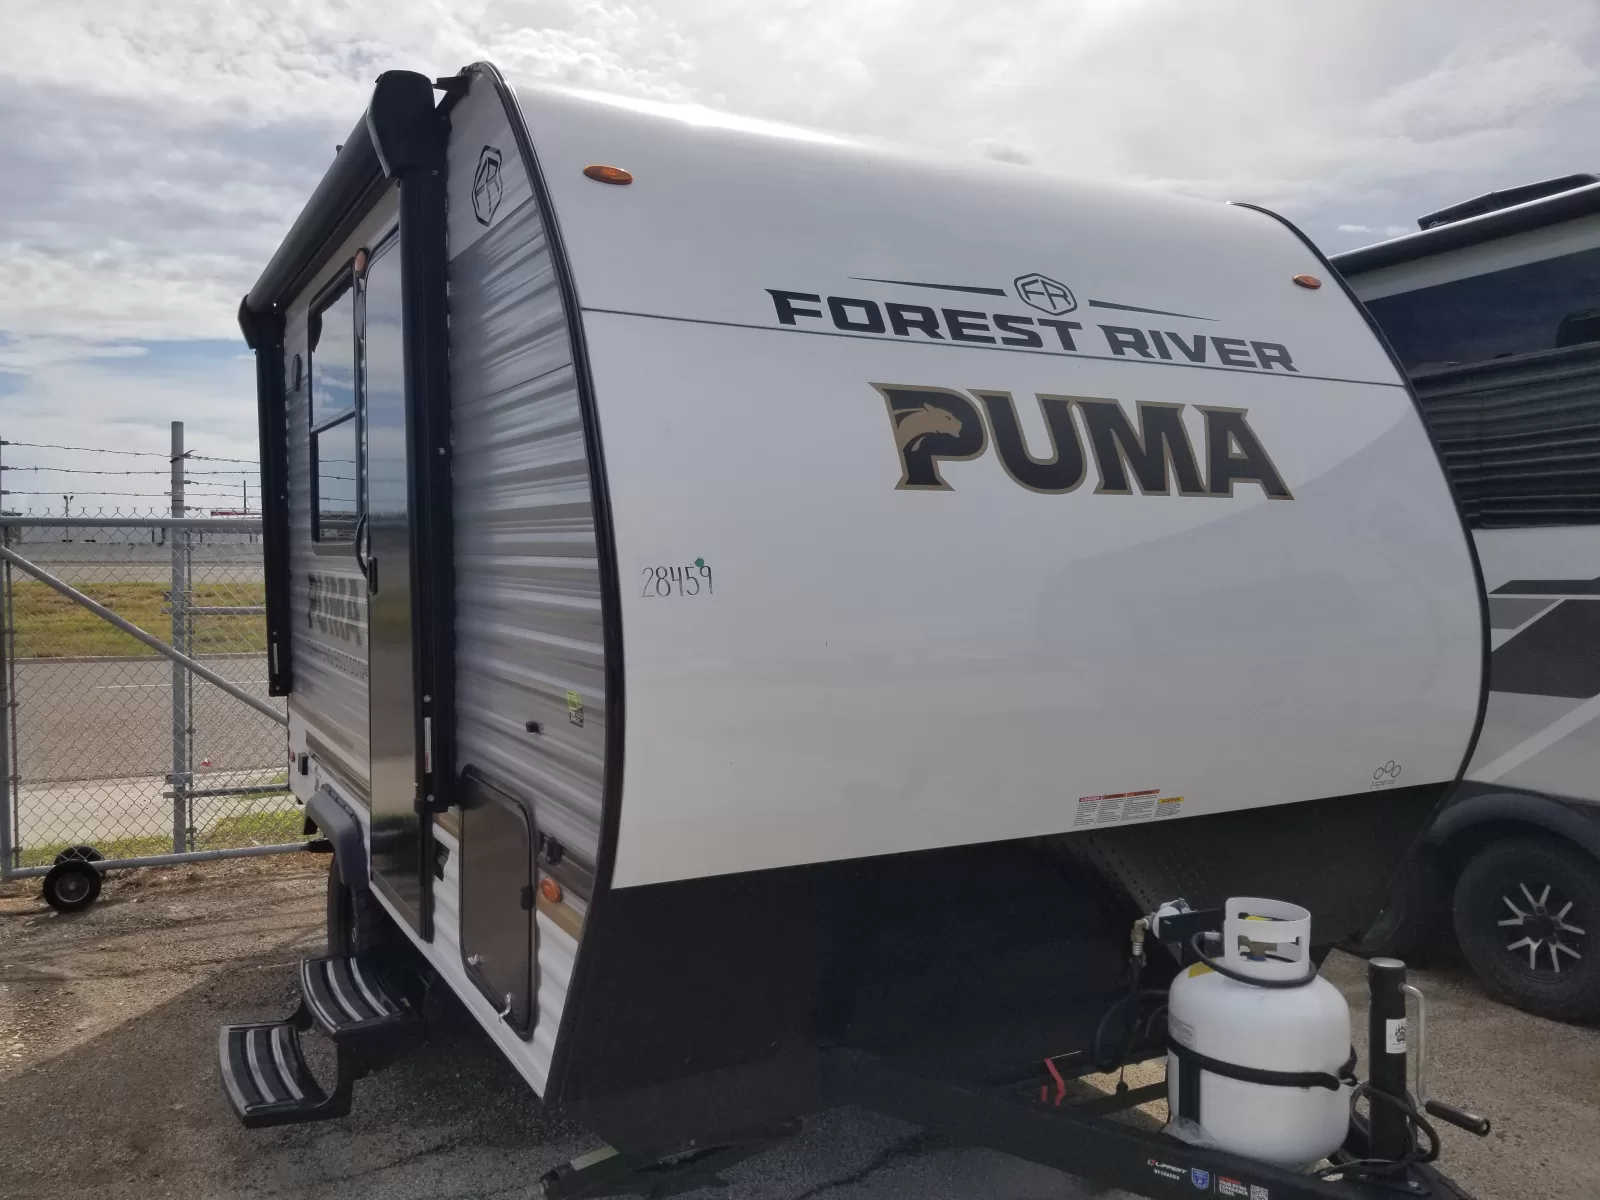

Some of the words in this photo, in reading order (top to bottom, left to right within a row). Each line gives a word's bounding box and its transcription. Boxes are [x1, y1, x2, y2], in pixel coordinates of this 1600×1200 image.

[765, 289, 1083, 351] FOREST
[1097, 324, 1300, 372] RIVER
[867, 382, 1295, 500] PUMA
[307, 573, 363, 649] PUMA
[642, 565, 713, 598] 28459
[1155, 1161, 1188, 1174] LIPPERT
